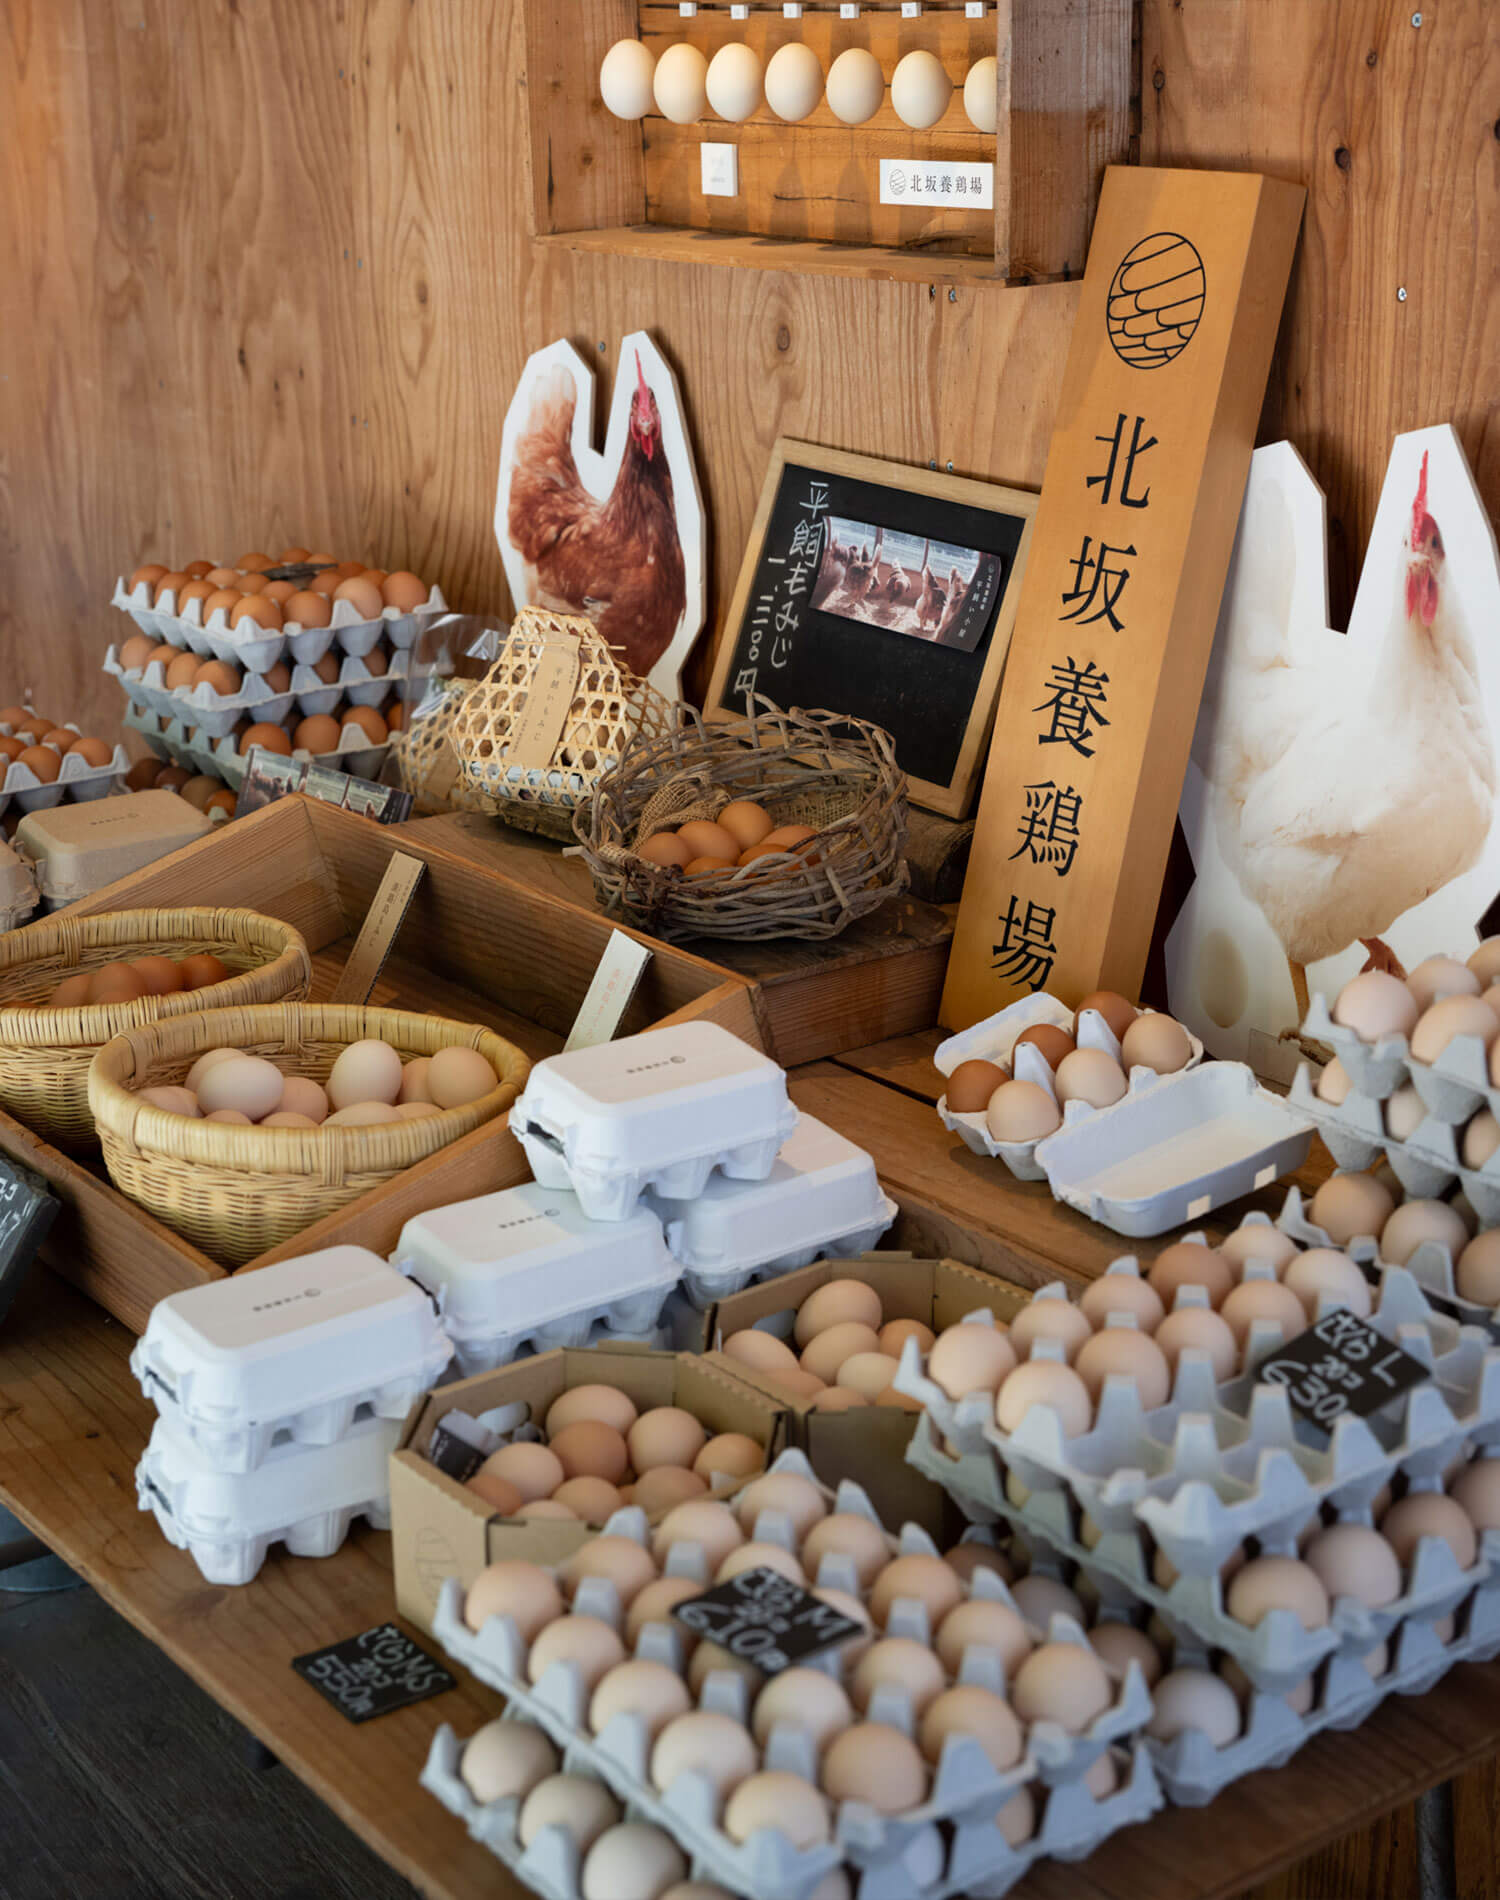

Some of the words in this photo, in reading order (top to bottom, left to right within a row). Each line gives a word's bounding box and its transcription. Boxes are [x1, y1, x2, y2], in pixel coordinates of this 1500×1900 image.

[910, 174, 983, 194] 北坂養鶏場
[771, 481, 830, 668] 平飼もみじ
[990, 413, 1159, 993] 北坂養鶏場
[1262, 1360, 1347, 1427] 630
[1371, 1350, 1403, 1387] L
